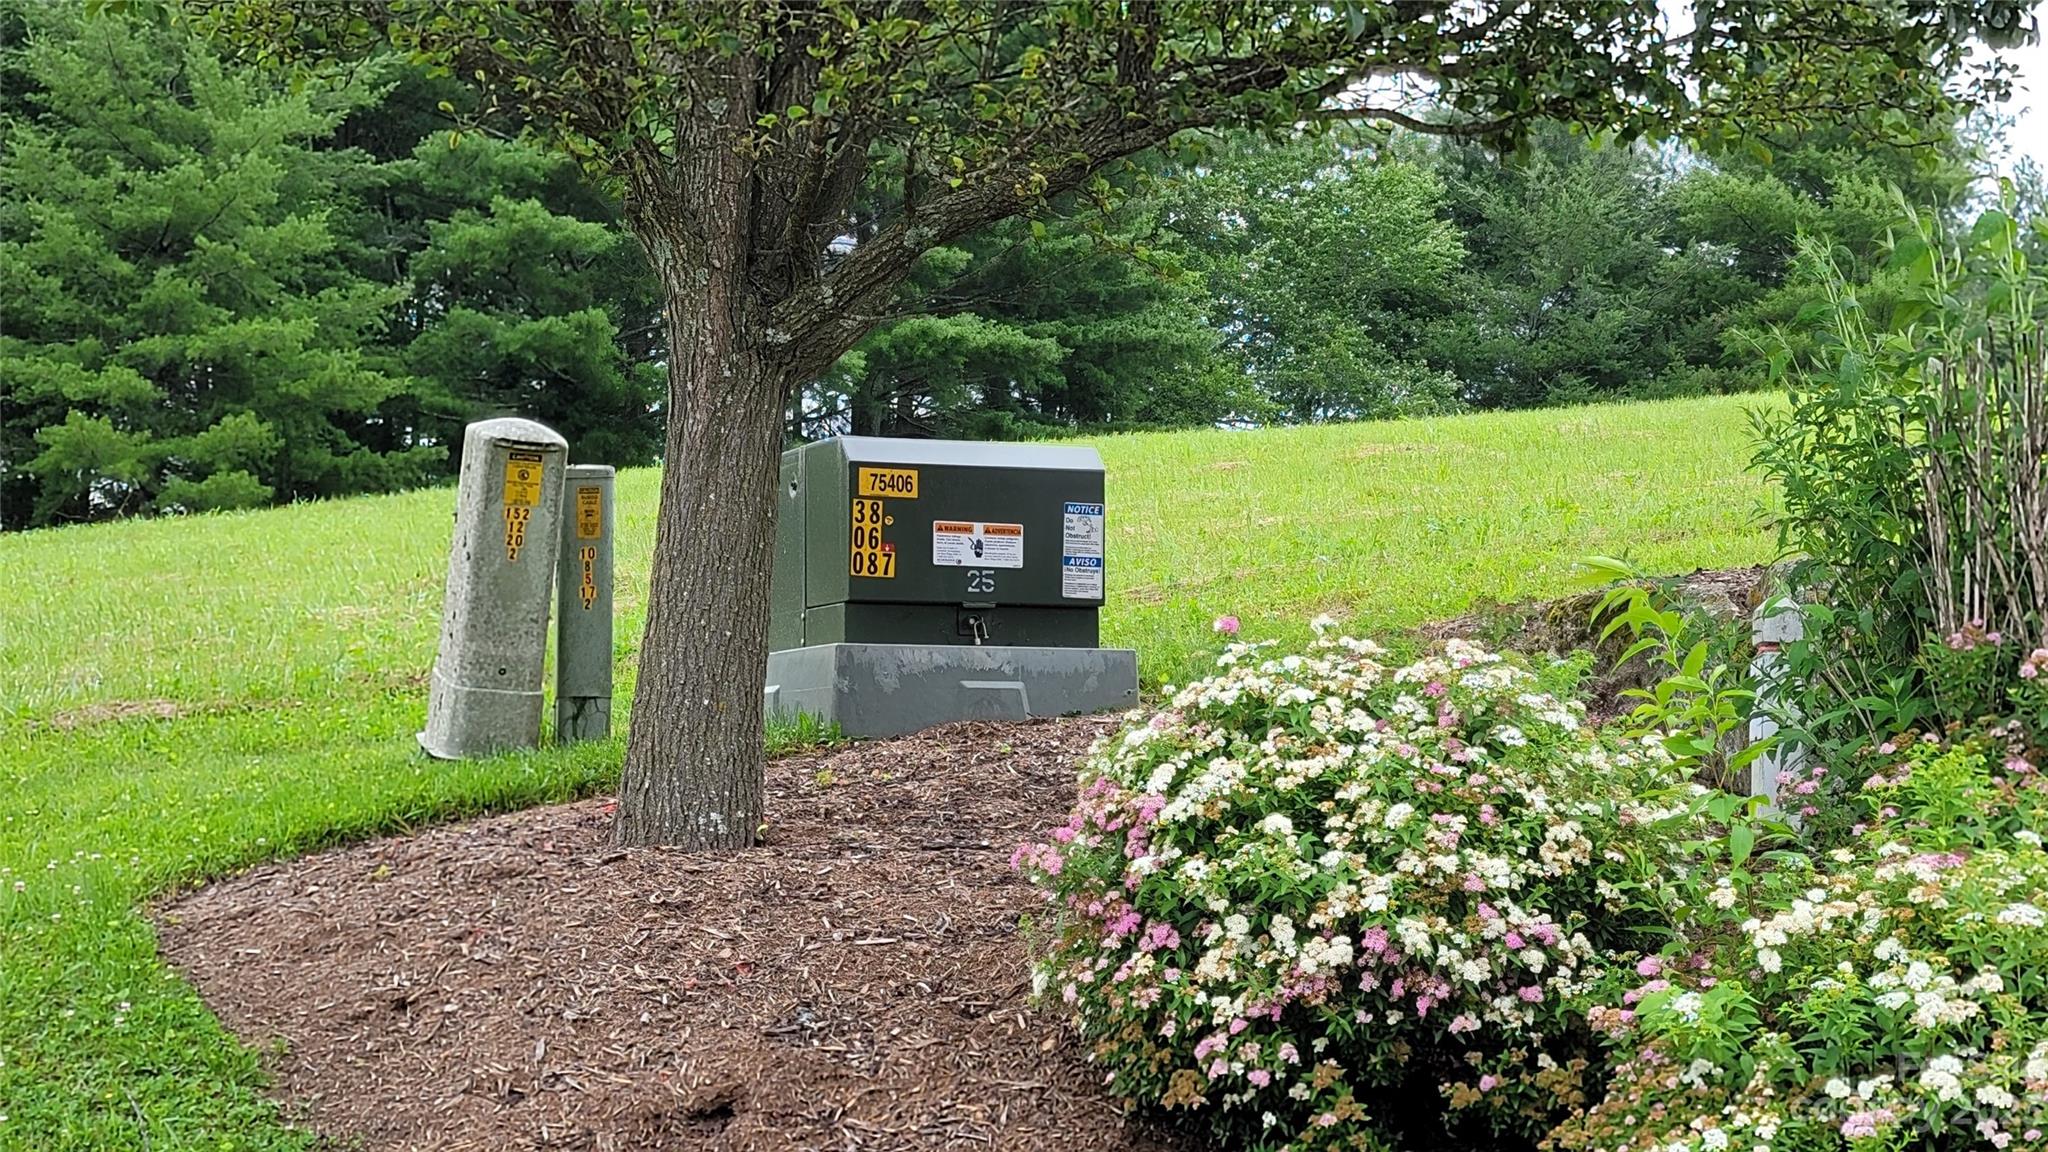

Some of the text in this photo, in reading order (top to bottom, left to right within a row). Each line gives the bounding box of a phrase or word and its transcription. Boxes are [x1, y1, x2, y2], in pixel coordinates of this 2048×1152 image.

[869, 473, 914, 493] 75406
[505, 508, 530, 521] 152
[854, 501, 880, 524] 38
[1067, 505, 1100, 515] NOTICE
[509, 522, 524, 533] 12
[943, 525, 973, 534] WARNING
[991, 527, 1022, 535] ADVERTENCIA
[506, 534, 523, 547] 20
[854, 526, 879, 550] 06
[509, 548, 516, 560] 2
[580, 548, 596, 560] 10
[584, 561, 591, 572] 8
[852, 551, 893, 576] 087
[1069, 558, 1097, 567] AVISO
[584, 573, 592, 584] 5
[967, 569, 995, 593] 25
[580, 586, 597, 598] 17
[584, 599, 591, 610] 2
